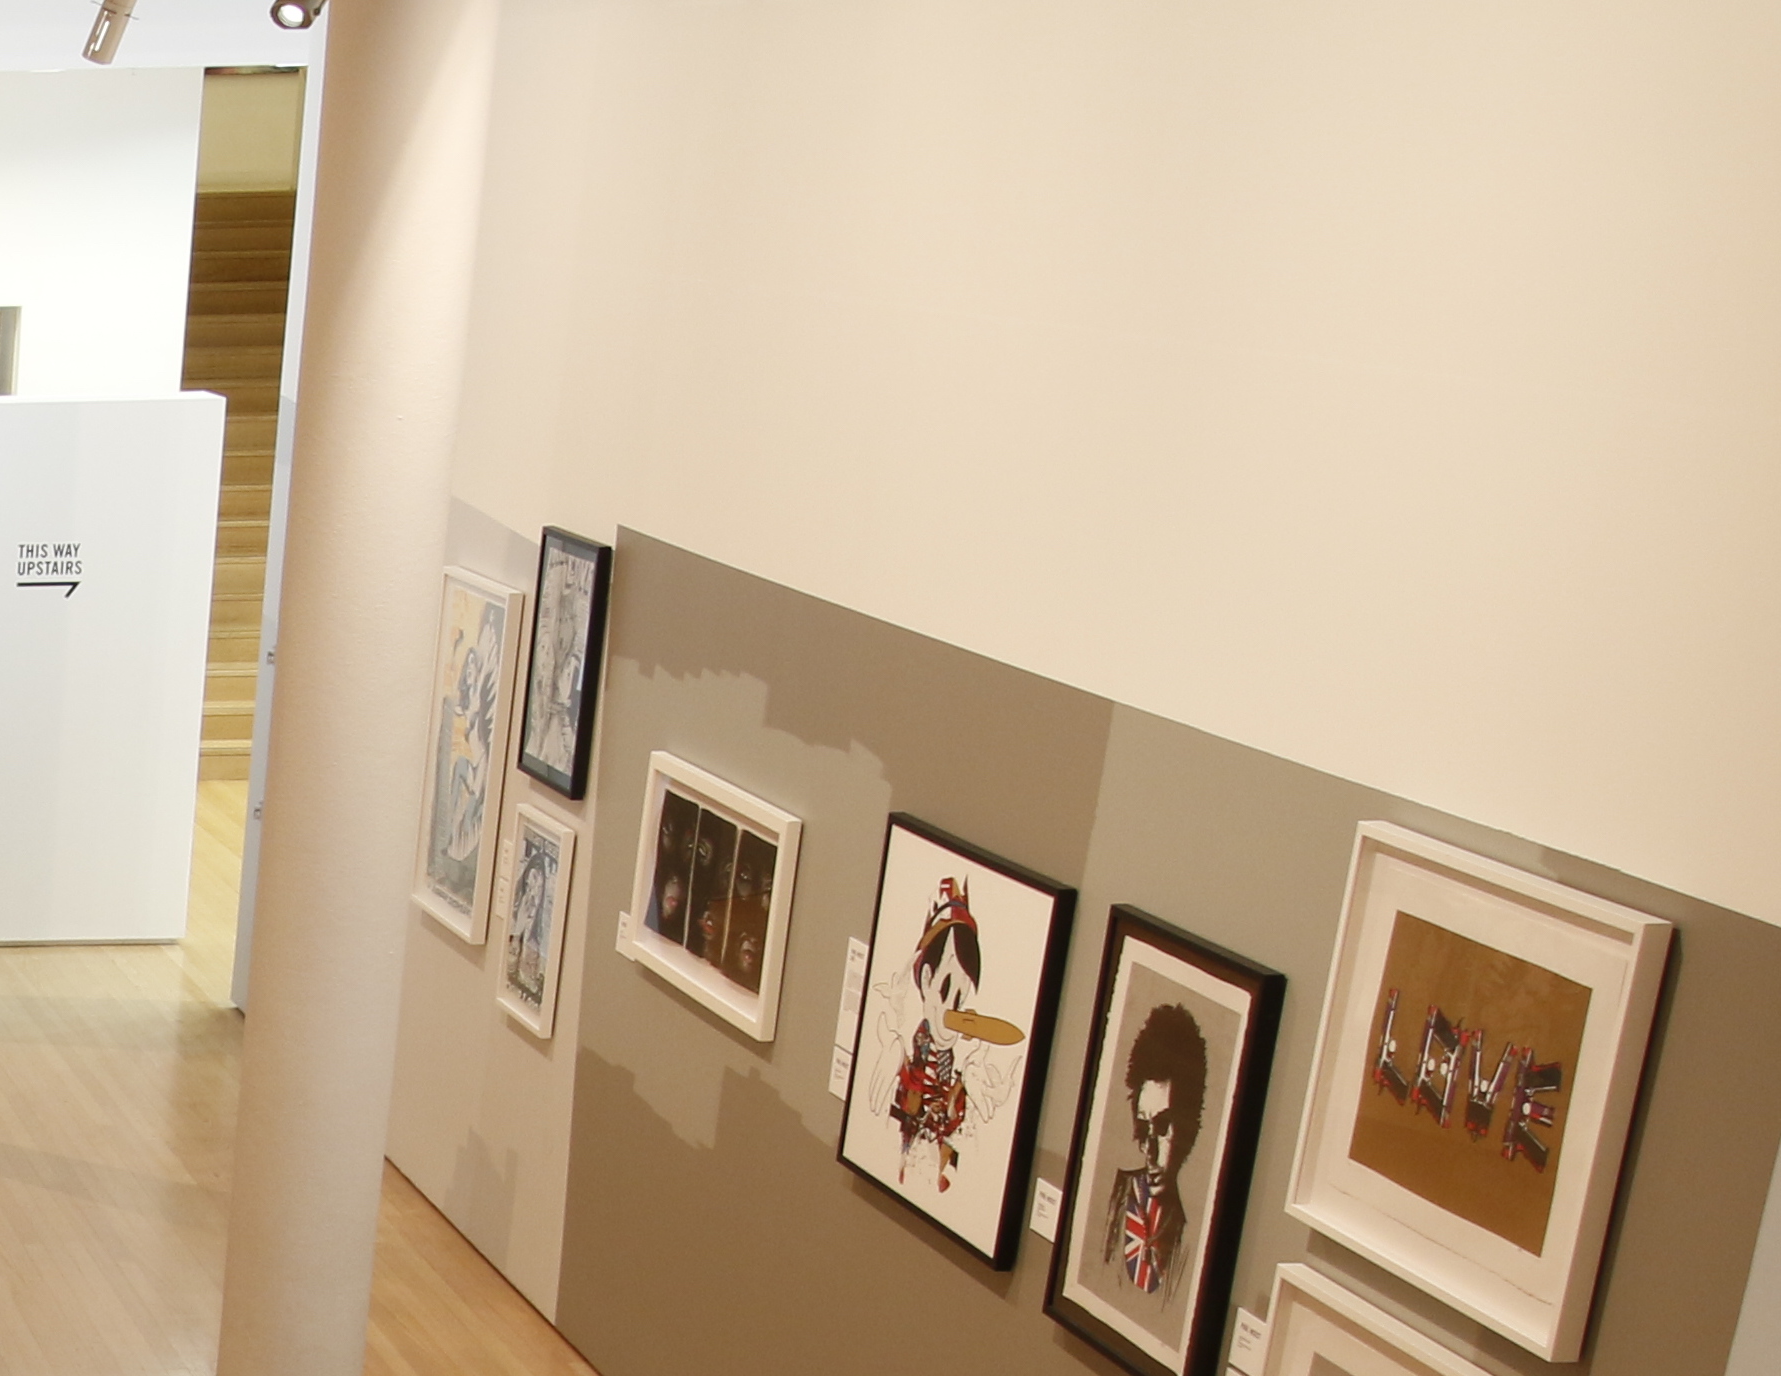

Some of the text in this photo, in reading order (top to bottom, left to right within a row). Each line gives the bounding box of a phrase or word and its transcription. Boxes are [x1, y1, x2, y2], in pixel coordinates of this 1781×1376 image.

[18, 543, 81, 559] THIS WAY
[17, 560, 83, 576] UPSTAIRS
[1372, 988, 1563, 1174] LOVE
